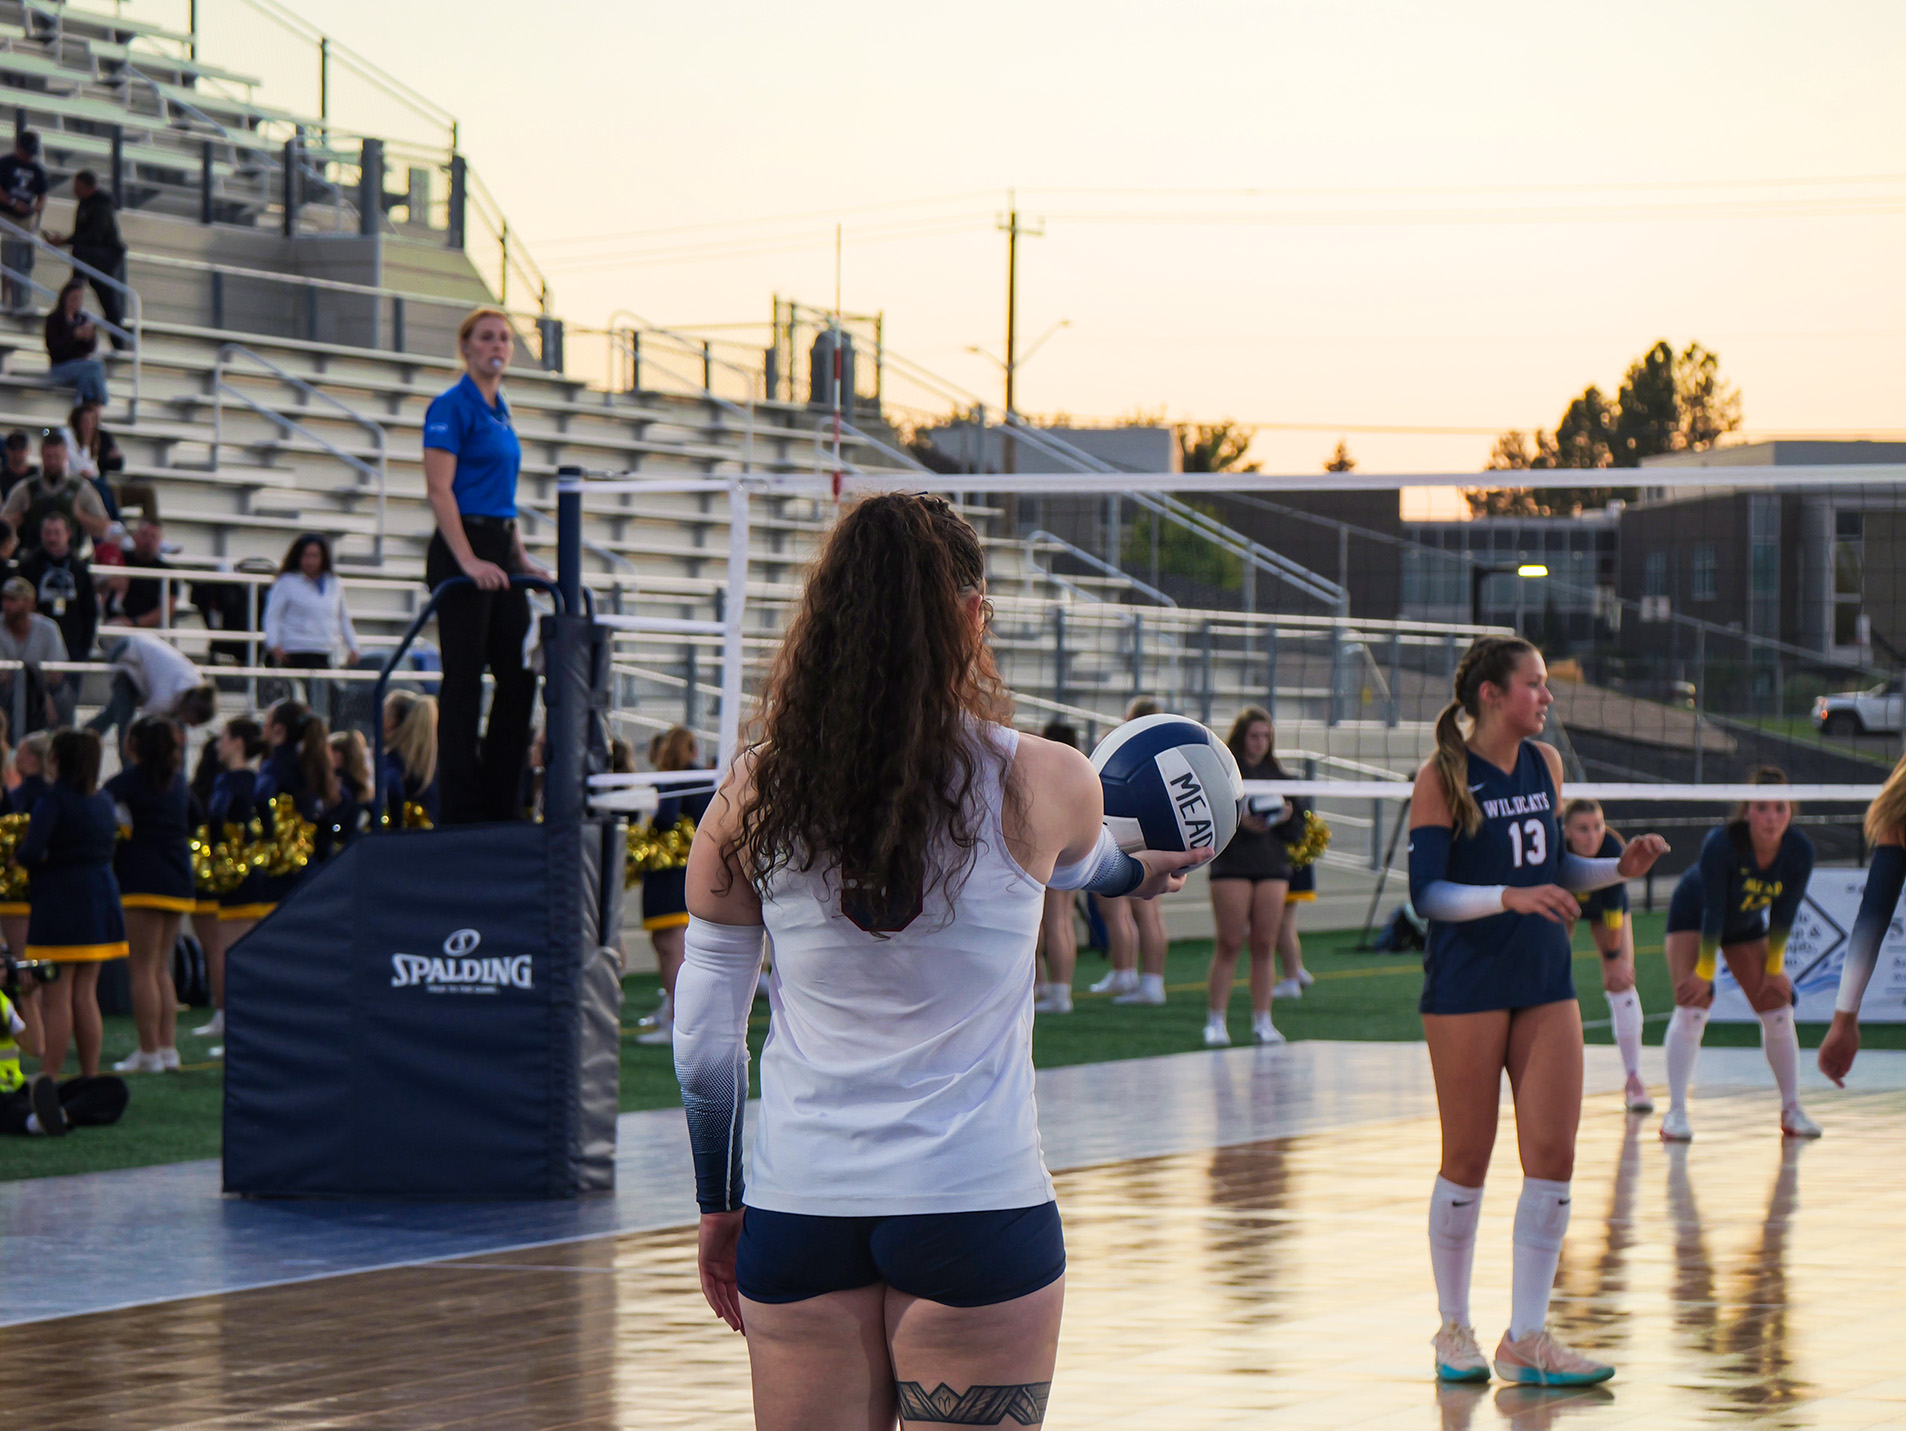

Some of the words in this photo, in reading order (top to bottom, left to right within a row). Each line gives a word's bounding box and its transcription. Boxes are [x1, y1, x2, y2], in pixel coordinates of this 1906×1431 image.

[1170, 772, 1213, 849] MEAD
[1482, 791, 1550, 819] WILDCATS
[1507, 818, 1548, 869] 13
[391, 953, 533, 989] SPALDING
